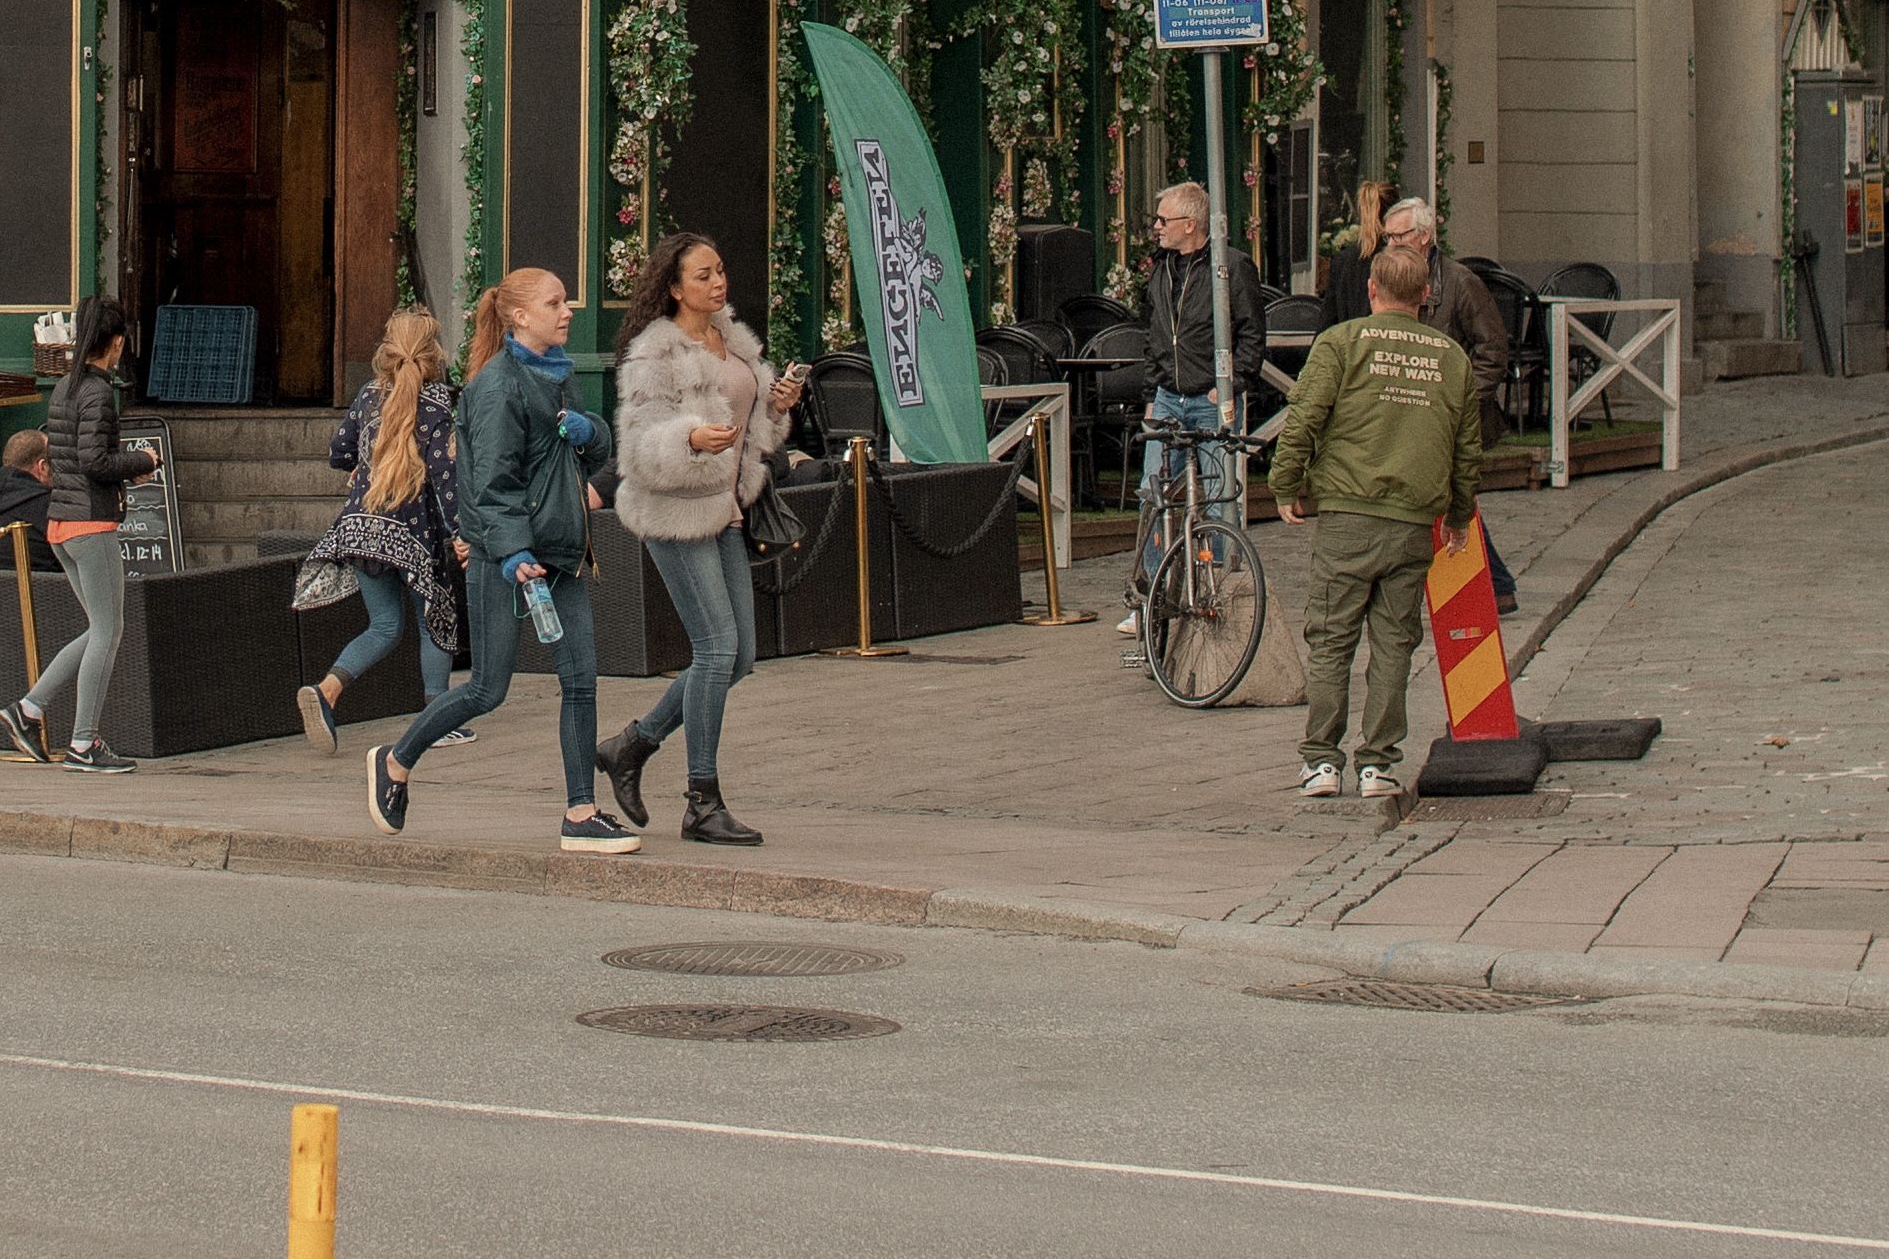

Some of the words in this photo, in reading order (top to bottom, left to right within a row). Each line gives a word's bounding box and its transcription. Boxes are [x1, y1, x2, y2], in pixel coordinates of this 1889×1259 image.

[1162, 0, 1189, 8] 11-06
[1187, 7, 1235, 17] Transport
[1185, 16, 1251, 27] rörelsehindrad
[1169, 29, 1200, 38] tillåten
[1202, 27, 1222, 36] hela
[1360, 328, 1451, 349] ADVENTURES
[1374, 351, 1439, 369] EXPLORE
[1369, 363, 1401, 378] NEW
[1405, 368, 1443, 382] WAYS
[1384, 386, 1427, 397] ANYWHERE
[1392, 396, 1431, 407] QUESTION
